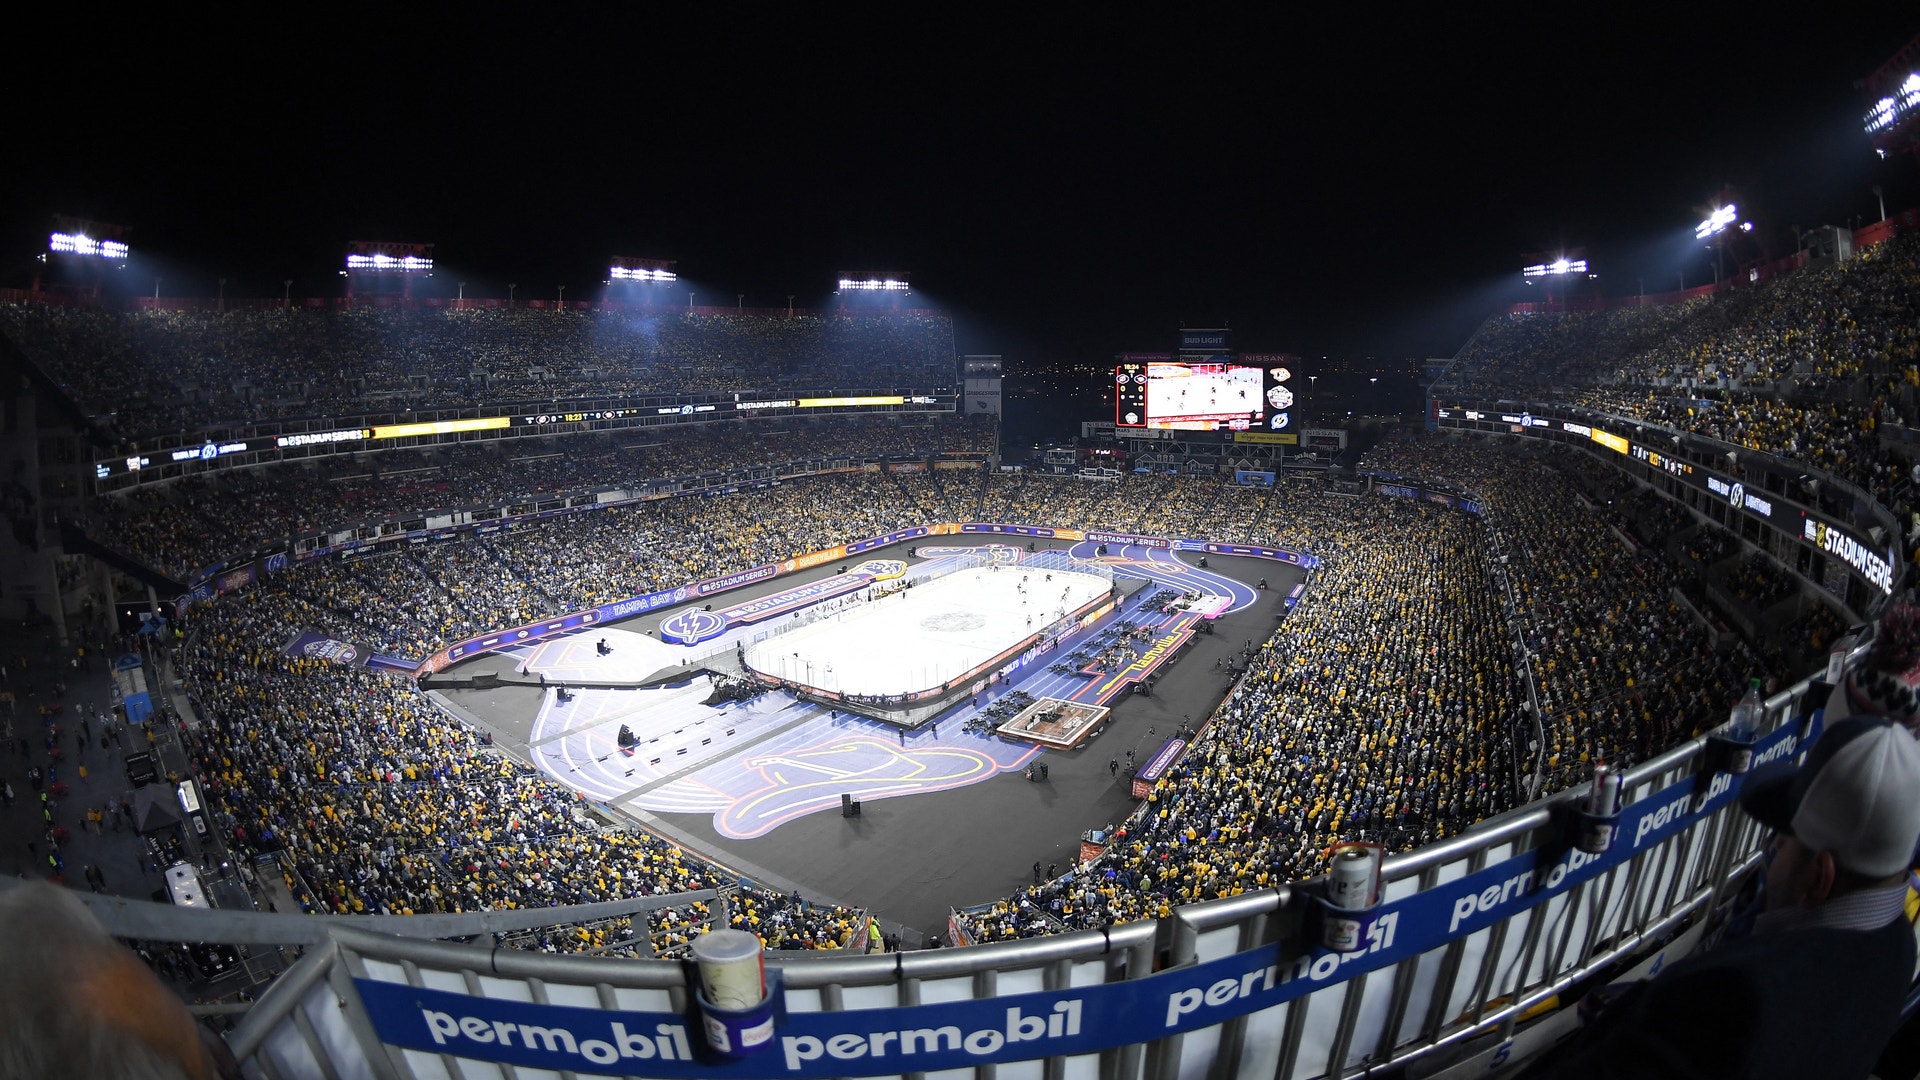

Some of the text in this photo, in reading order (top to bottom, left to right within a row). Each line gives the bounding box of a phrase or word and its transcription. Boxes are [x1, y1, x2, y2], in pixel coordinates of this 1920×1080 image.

[564, 413, 583, 422] 18:23
[295, 432, 332, 445] STADIUM
[332, 429, 363, 442] SERIES
[1380, 484, 1412, 498] BOLTS
[1103, 534, 1134, 544] STADIUM
[800, 549, 839, 567] NASHVILLE
[1824, 527, 1868, 573] STADIUM
[1864, 551, 1893, 595] SERIE
[715, 569, 768, 590] STADIUM SERIES
[754, 574, 860, 609] STADIUM SERIES
[613, 592, 671, 616] TAMPA BAY
[1648, 952, 1665, 976] 4
[421, 1008, 694, 1066] permobil
[781, 999, 1084, 1071] permobil
[1490, 1041, 1514, 1070] 5
